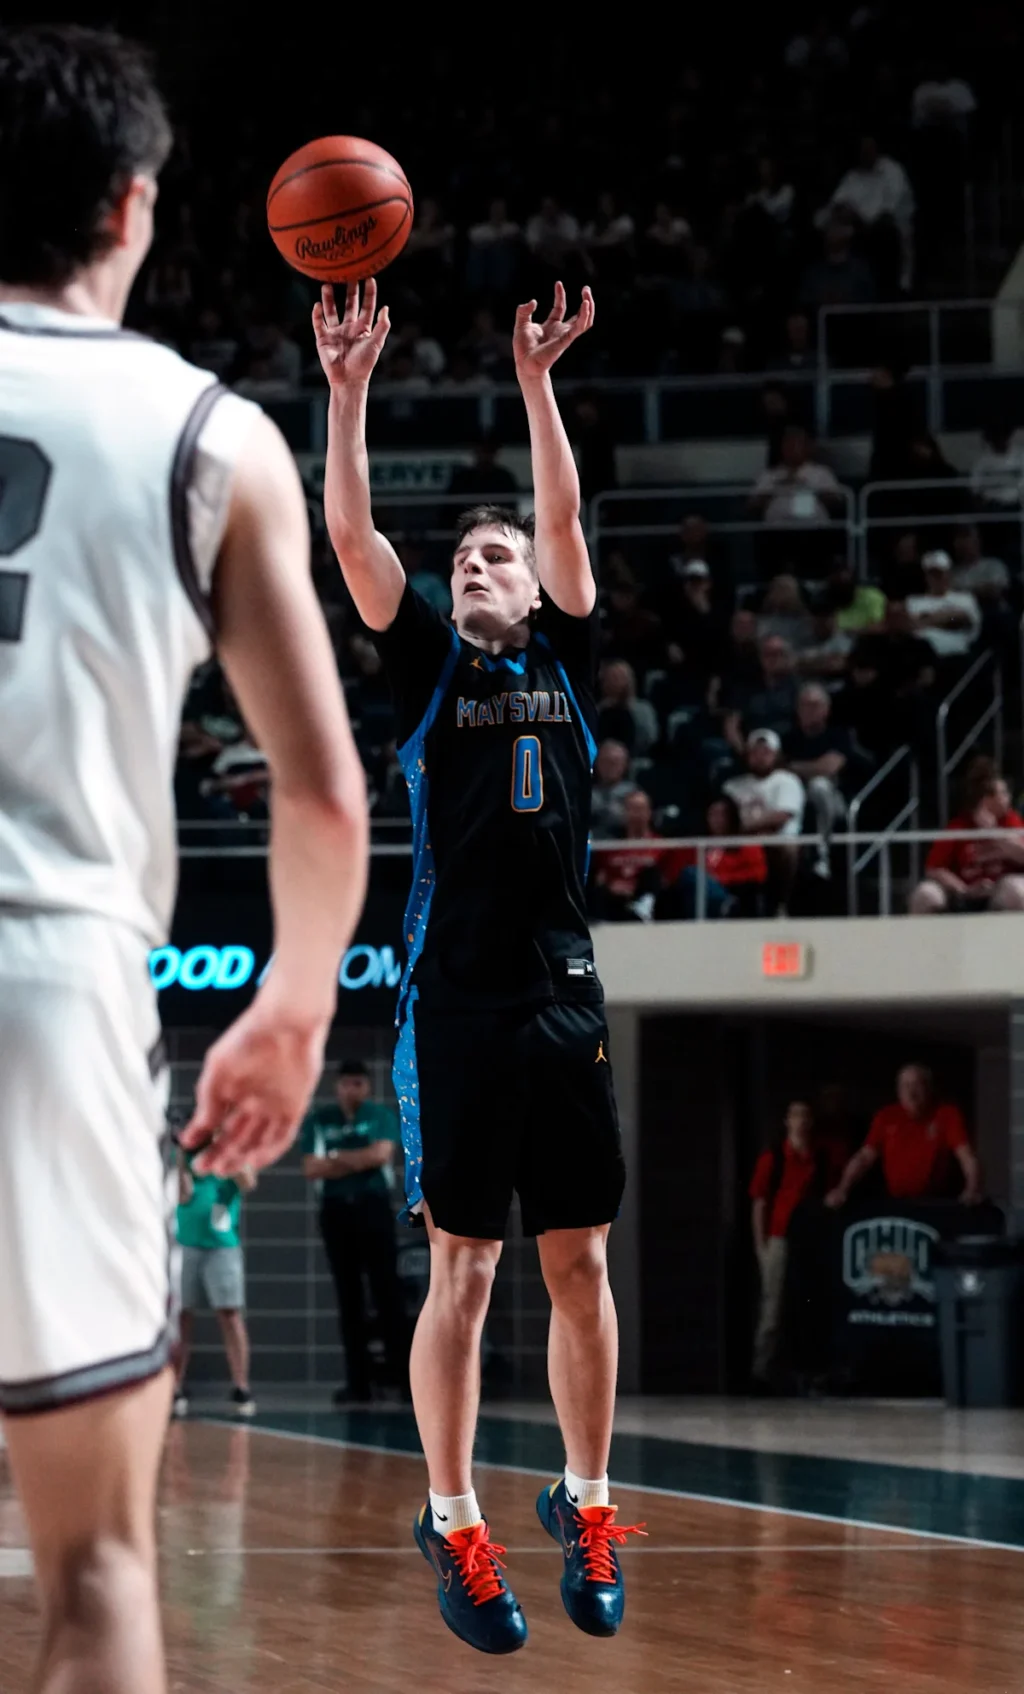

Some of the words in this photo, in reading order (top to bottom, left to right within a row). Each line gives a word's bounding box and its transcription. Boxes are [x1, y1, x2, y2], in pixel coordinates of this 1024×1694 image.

[295, 216, 377, 260] Rawlings
[313, 462, 445, 482] RERVE
[511, 735, 544, 813] 0
